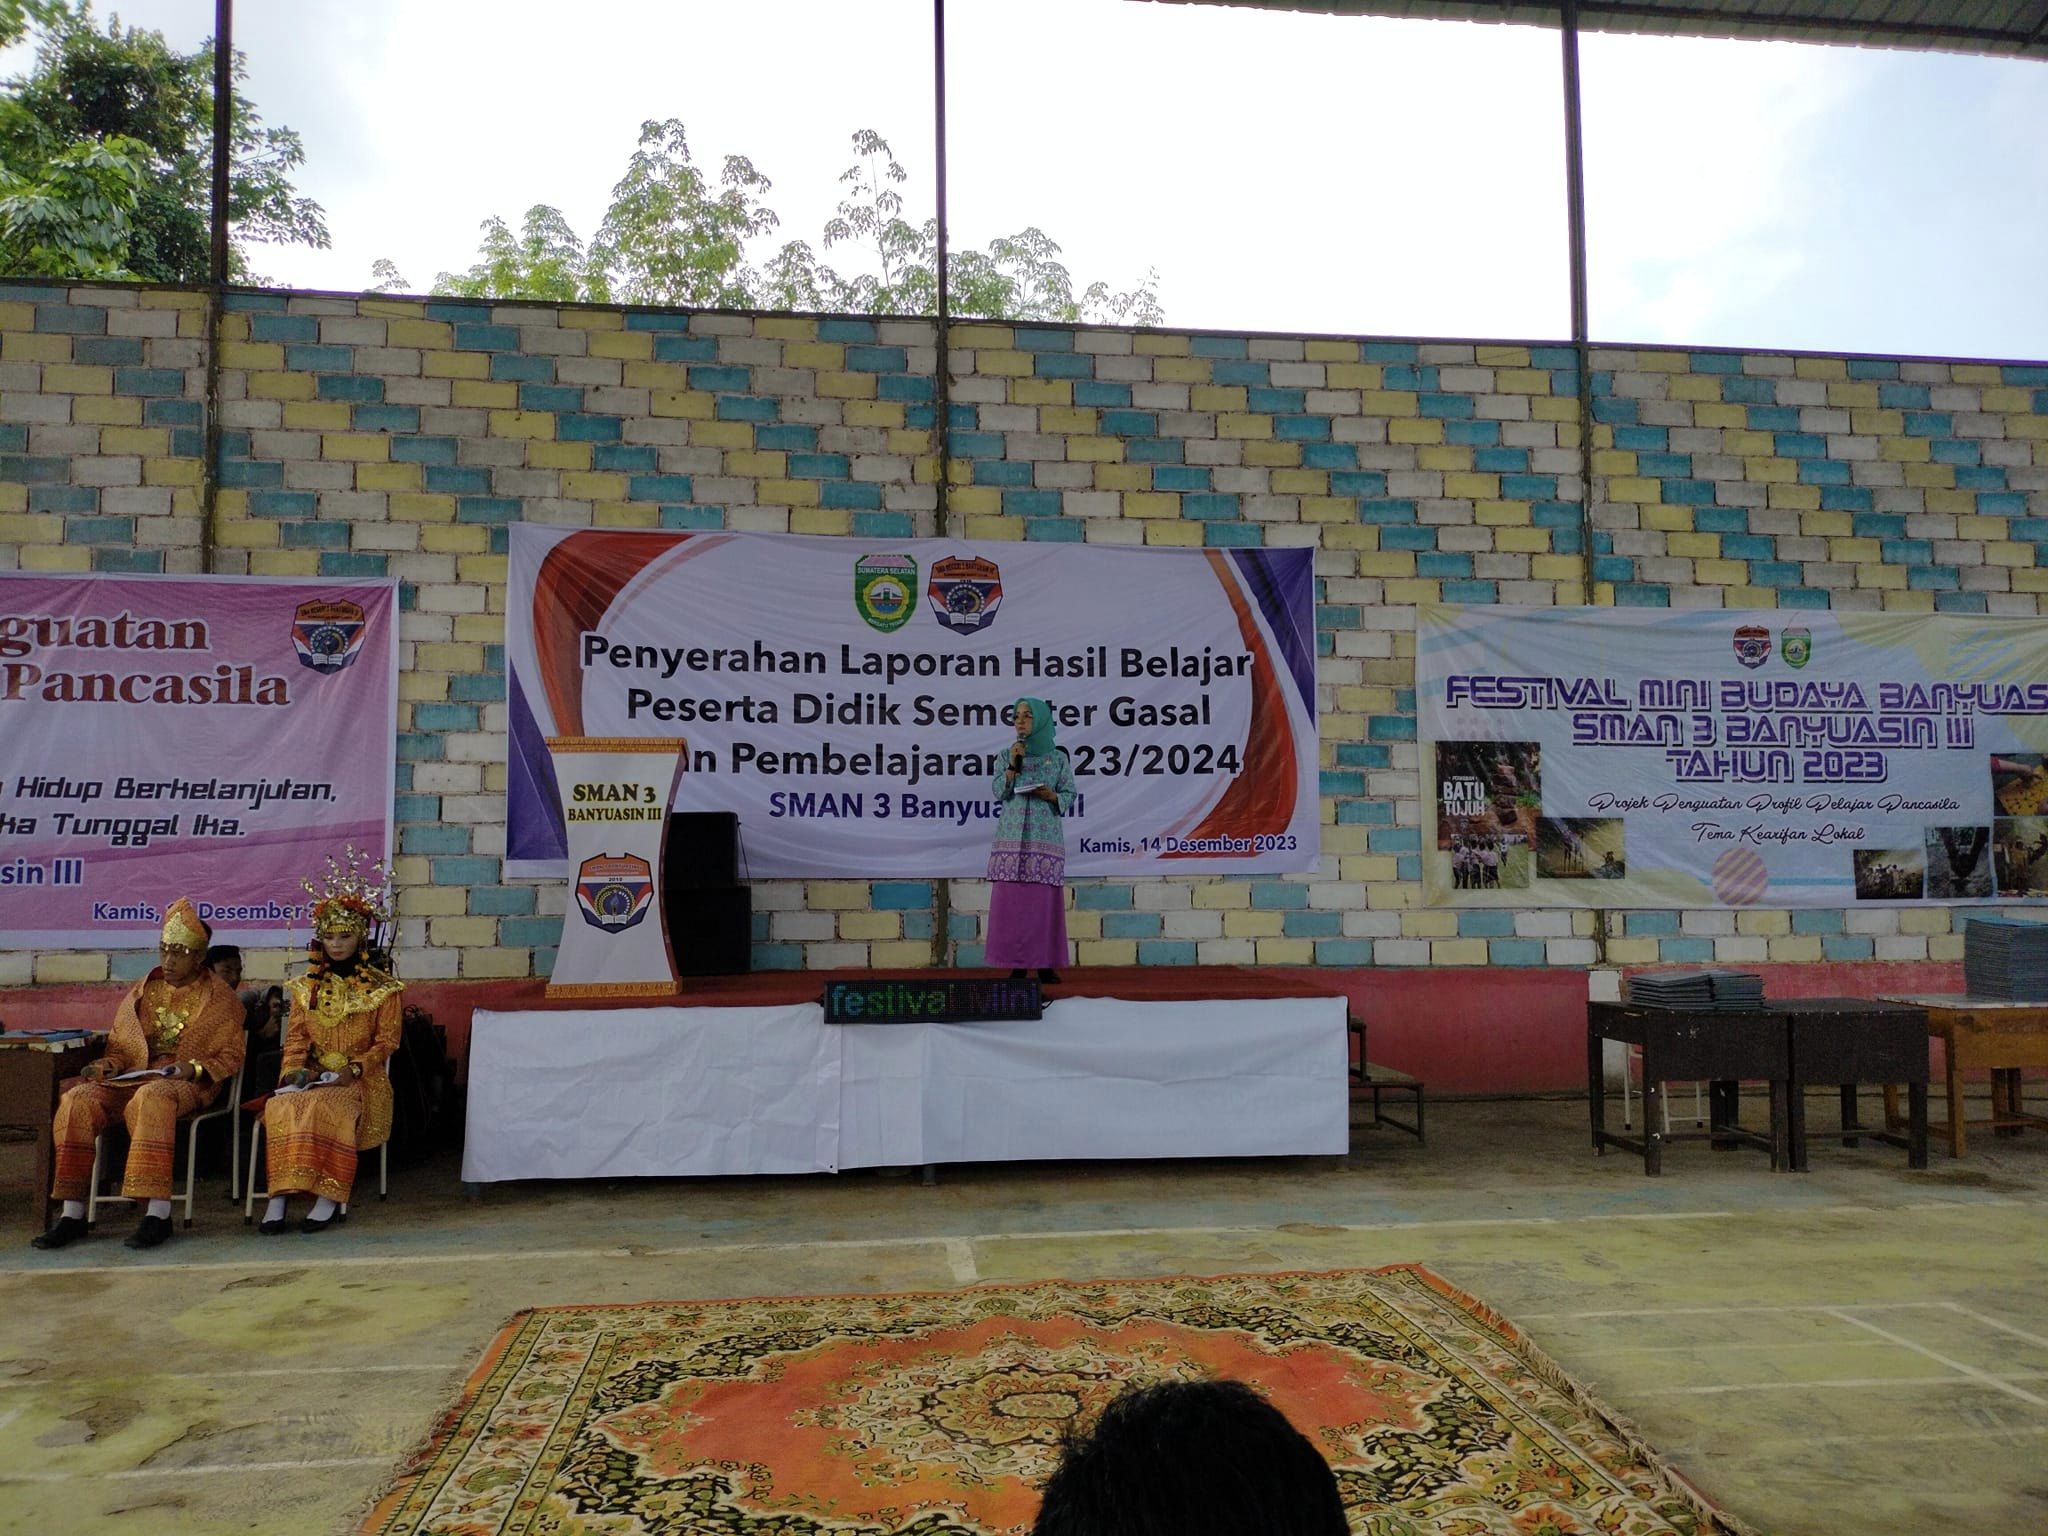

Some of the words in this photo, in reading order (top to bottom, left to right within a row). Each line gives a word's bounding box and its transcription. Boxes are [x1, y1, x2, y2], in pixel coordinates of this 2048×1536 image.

[0, 612, 209, 656] guatan
[584, 635, 826, 678] Penyerahan
[841, 644, 1000, 685] Laporan
[1014, 646, 1107, 679] Hasil
[1121, 647, 1251, 686] Belajar
[2, 663, 291, 705] Pancasila
[1446, 676, 1632, 711] FESTIVAL
[1639, 679, 1712, 712] MINI
[1721, 680, 1872, 713] BUDAYA
[628, 688, 779, 724] Peserta
[793, 692, 902, 726] Didik
[913, 694, 1097, 727] Semeter
[1109, 694, 1211, 728] Gasal
[1572, 713, 1683, 747] SMAN
[1692, 714, 1716, 747] 3
[1726, 715, 1938, 749] BANYUASIN
[1946, 716, 1974, 749] III
[1056, 744, 1241, 778] 23/2024
[1665, 749, 1794, 784] TAHUN
[1803, 751, 1888, 783] 2023
[15, 776, 103, 803] Hidup
[114, 777, 337, 810] Berkelanjutan,
[572, 783, 639, 802] SMAN
[643, 786, 656, 804] 3
[769, 791, 863, 819] SMAN
[873, 793, 891, 820] 3
[1443, 781, 1485, 801] BATU
[1588, 792, 1650, 812] Projek
[1653, 793, 1742, 813] Penguatan
[1746, 793, 1802, 814] Profil
[1806, 794, 1873, 814] Pelajar
[1877, 794, 1960, 814] Pancasila
[568, 807, 645, 821] BANYUASIN
[647, 807, 662, 821] III
[1443, 800, 1485, 816] TUJUH
[53, 813, 178, 847] Tunggal
[192, 813, 246, 836] Ika.
[1691, 822, 1736, 843] Tema
[1739, 824, 1808, 845] Kearifan
[1811, 823, 1866, 845] Lokal
[1080, 837, 1135, 856] Kamis,
[1141, 837, 1161, 853] 14
[1166, 836, 1250, 853] Desember
[1254, 836, 1297, 852] 2023
[0, 859, 43, 884] sin
[54, 860, 82, 884] III
[93, 902, 160, 923] Kamis,
[199, 902, 302, 920] Desember
